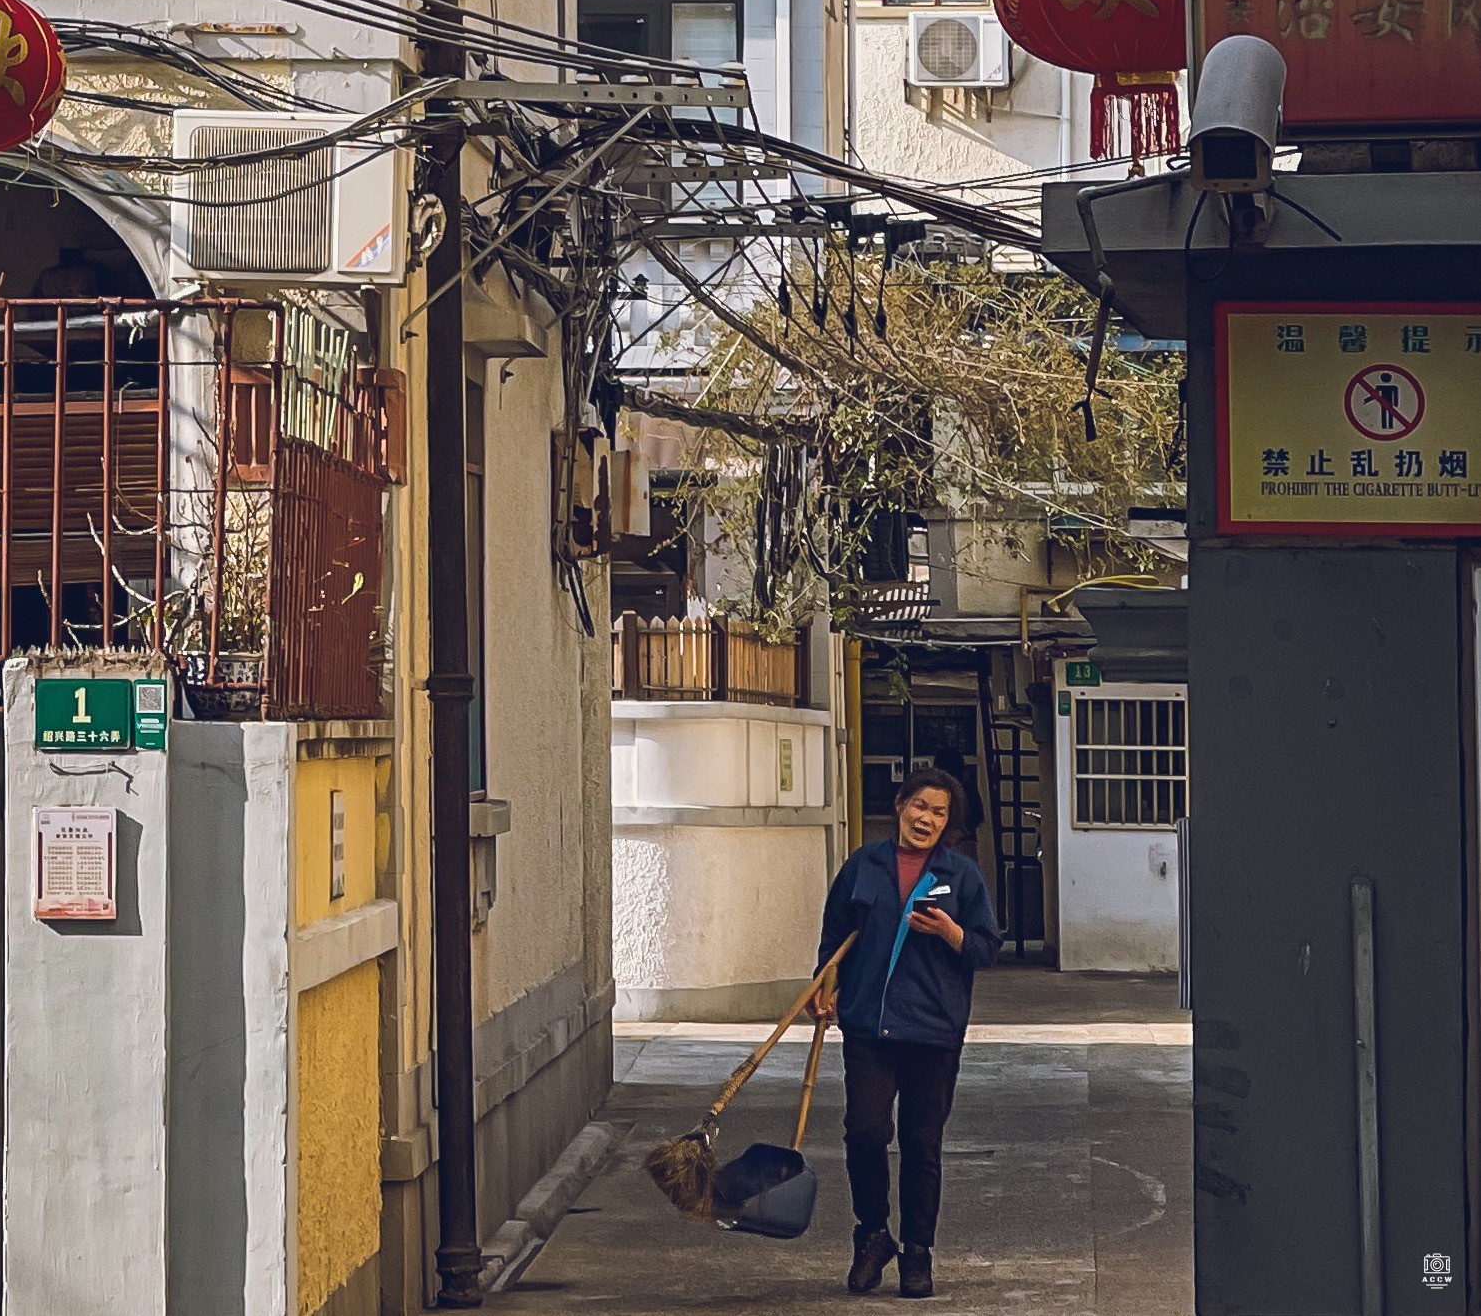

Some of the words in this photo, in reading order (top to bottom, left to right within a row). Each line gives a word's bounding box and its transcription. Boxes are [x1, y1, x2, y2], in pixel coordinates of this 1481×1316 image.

[1261, 448, 1468, 478] 禁止乱扔烟
[1260, 481, 1320, 497] PROHIBIT
[1324, 482, 1351, 497] THE
[1352, 482, 1423, 497] CIGARETTE
[1426, 482, 1481, 497] BUTT-LI
[72, 687, 92, 724] 1
[42, 730, 121, 743] 绍兴路三十六弄
